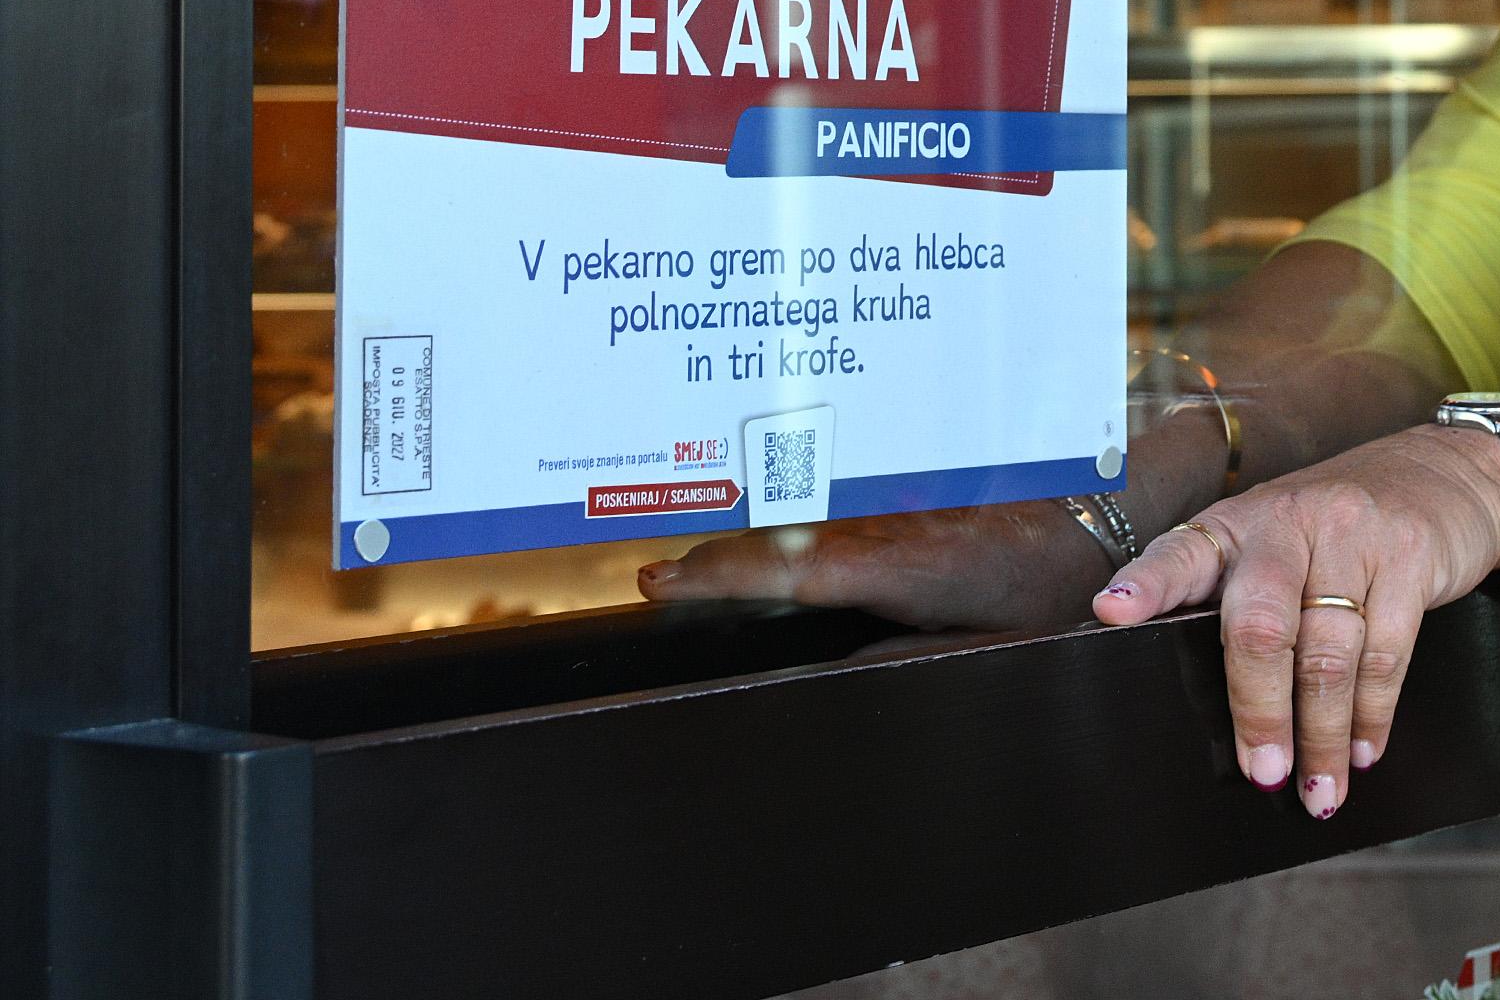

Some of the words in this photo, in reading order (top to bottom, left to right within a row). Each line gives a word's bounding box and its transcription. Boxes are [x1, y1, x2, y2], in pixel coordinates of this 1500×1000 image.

[816, 120, 971, 159] PANIFICIO
[518, 239, 546, 281] V
[563, 238, 694, 293] pekarno
[710, 248, 785, 290] grem
[800, 247, 836, 287] po
[849, 233, 902, 273] dva
[915, 232, 1006, 271] hlebca
[610, 290, 839, 346] polnozrnatega
[853, 282, 932, 323] kruha
[372, 345, 381, 404] IMPOSTA
[422, 347, 432, 406] COMUNE
[687, 343, 712, 382] in
[728, 340, 764, 381] tri
[779, 335, 864, 378] krofe.
[364, 380, 373, 453] SCADENZE
[414, 368, 423, 420] ESATTO
[422, 408, 432, 421] DI
[422, 422, 432, 480] TRIESTE
[538, 457, 570, 472] Preveri
[572, 456, 594, 471] svoje
[596, 453, 624, 469] znanje
[626, 454, 636, 465] na
[638, 450, 668, 467] portalu
[674, 440, 703, 463] SMEJ
[595, 490, 660, 509] POSKENIRAJ
[670, 486, 727, 504] SCANSIONA
